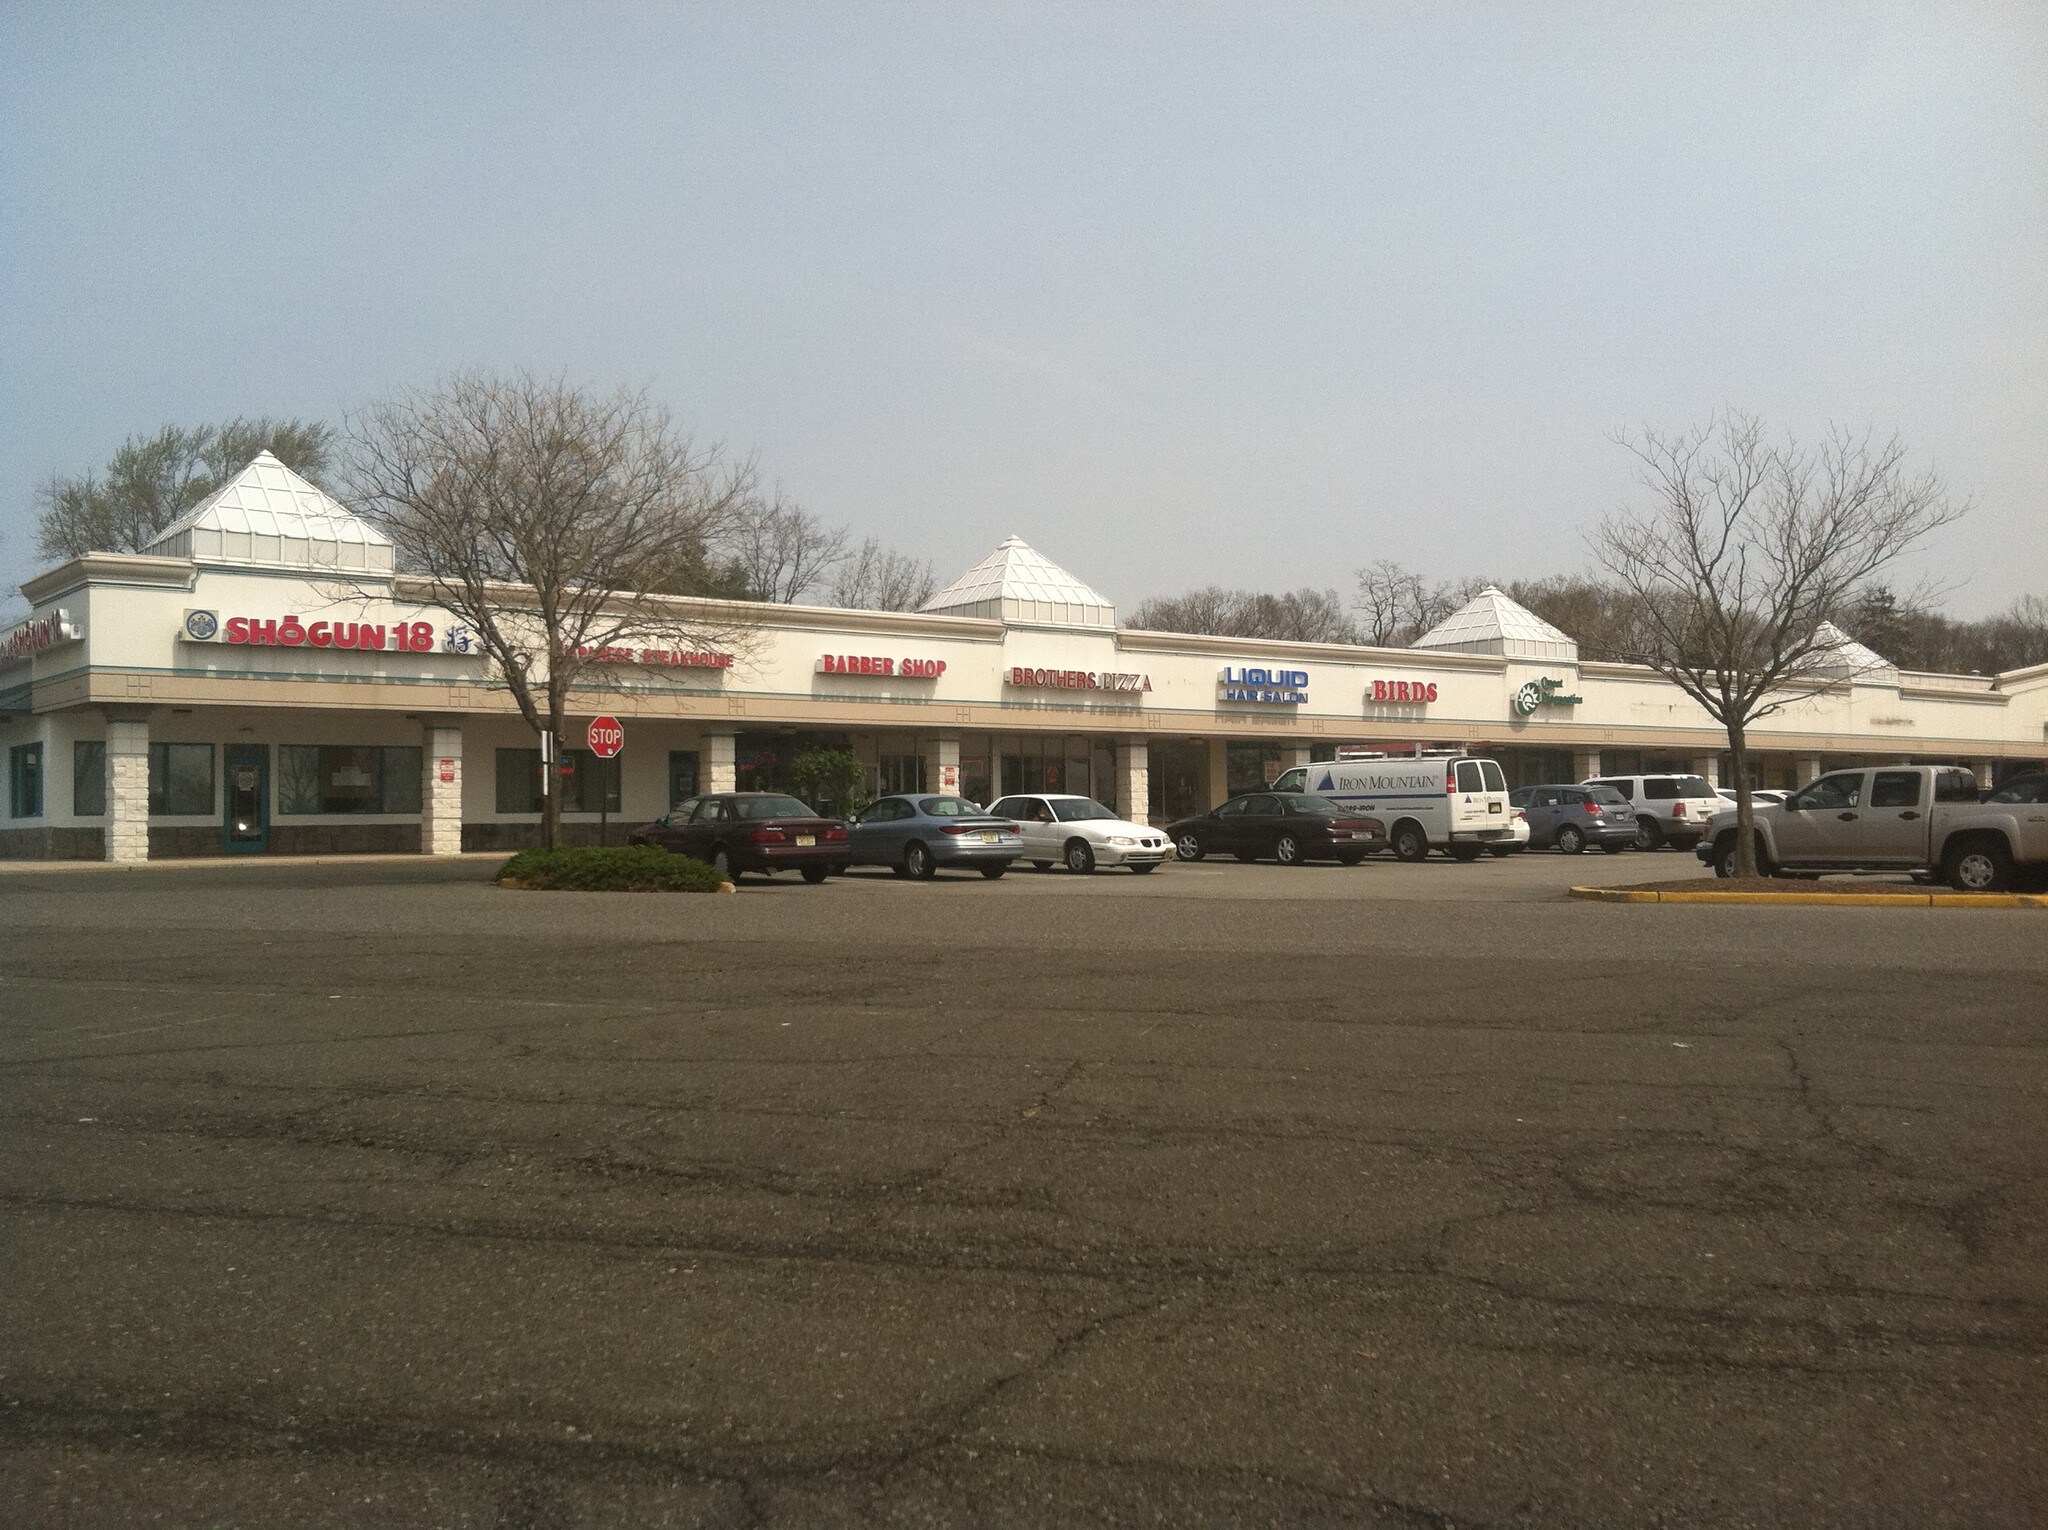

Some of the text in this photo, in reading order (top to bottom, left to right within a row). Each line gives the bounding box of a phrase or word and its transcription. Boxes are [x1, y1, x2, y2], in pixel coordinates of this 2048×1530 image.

[226, 615, 434, 652] SHŌGUN 18
[642, 648, 735, 669] STEAKHOUSE
[822, 654, 947, 678] BARBER SHOP
[1011, 667, 1153, 692] BROTHERS PIZZA
[1225, 667, 1309, 688] LIQUID
[1226, 688, 1309, 704] HAIR SALON
[1373, 680, 1438, 703] BIRDS
[591, 728, 621, 745] STOP
[1339, 775, 1435, 790] IRON MOUNTAIN
